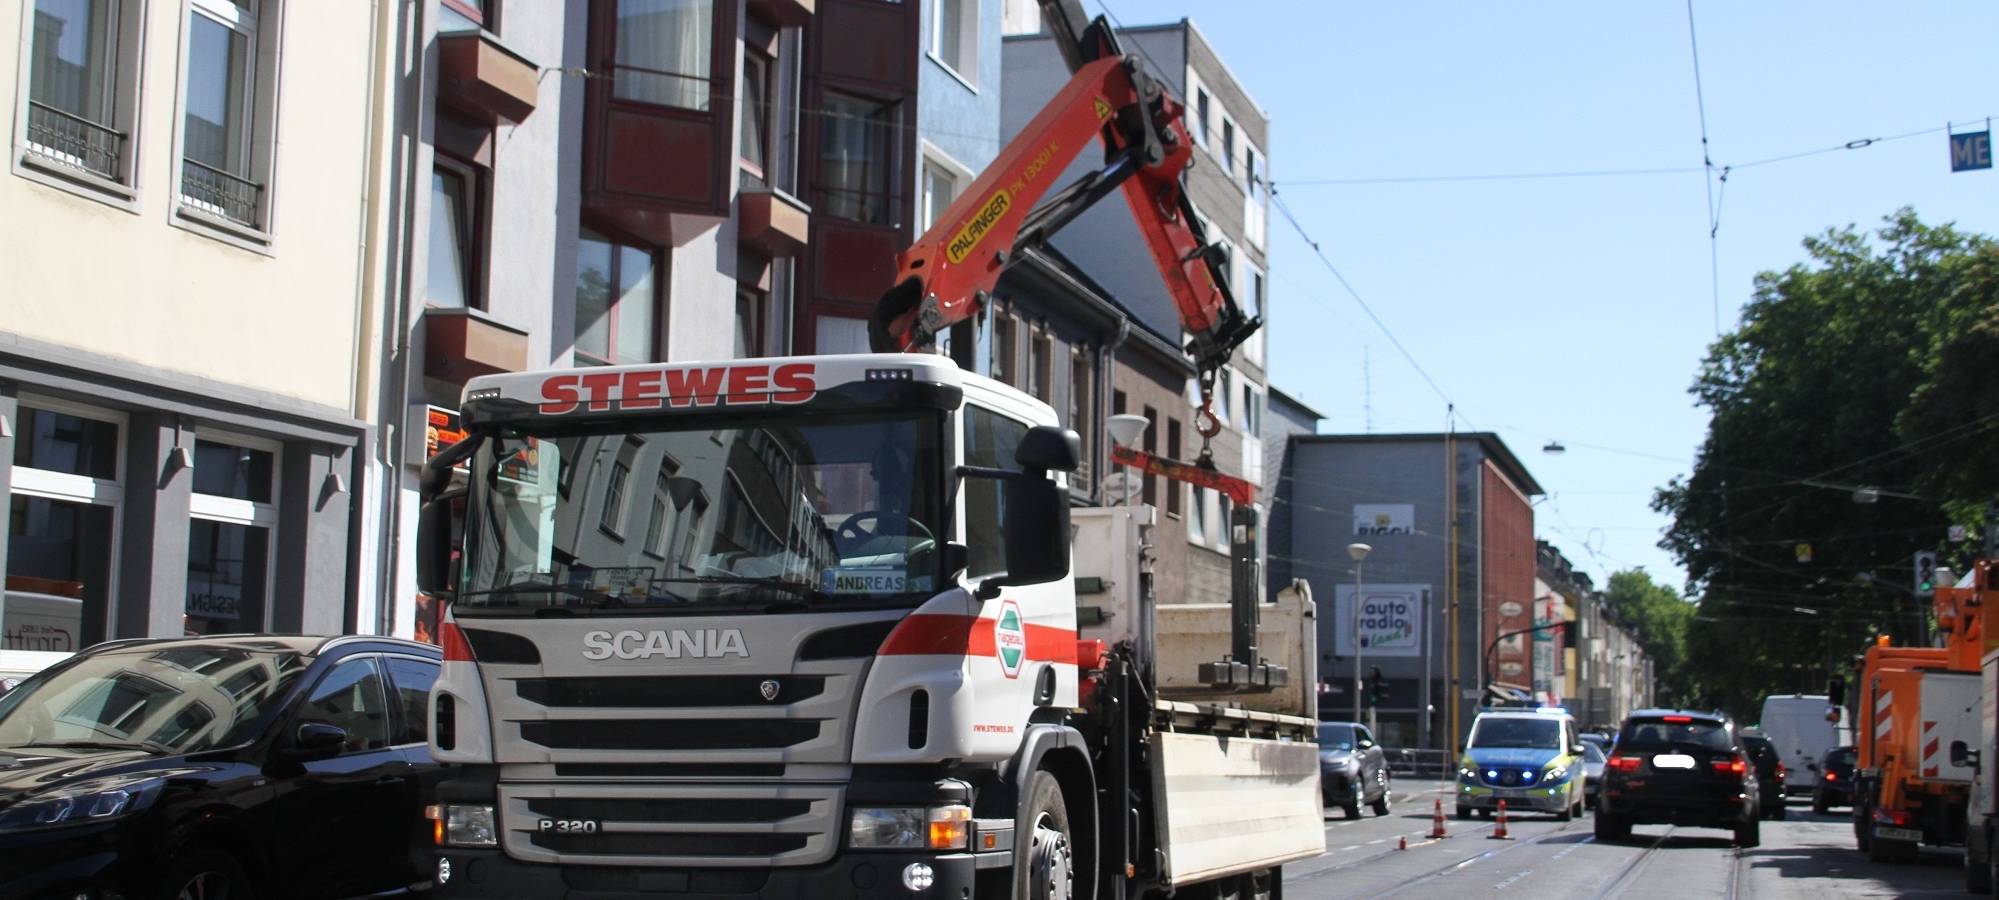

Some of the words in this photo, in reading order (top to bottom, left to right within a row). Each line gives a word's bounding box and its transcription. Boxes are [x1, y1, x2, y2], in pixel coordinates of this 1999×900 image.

[950, 194, 1008, 260] PALFINGER
[1009, 178, 1025, 199] PK
[539, 363, 816, 415] STEWES
[835, 576, 904, 591] ANDREAS
[1365, 602, 1406, 615] auto
[1359, 614, 1405, 629] radio
[583, 629, 749, 660] SCANIA
[540, 820, 553, 833] P
[556, 820, 597, 833] 320
